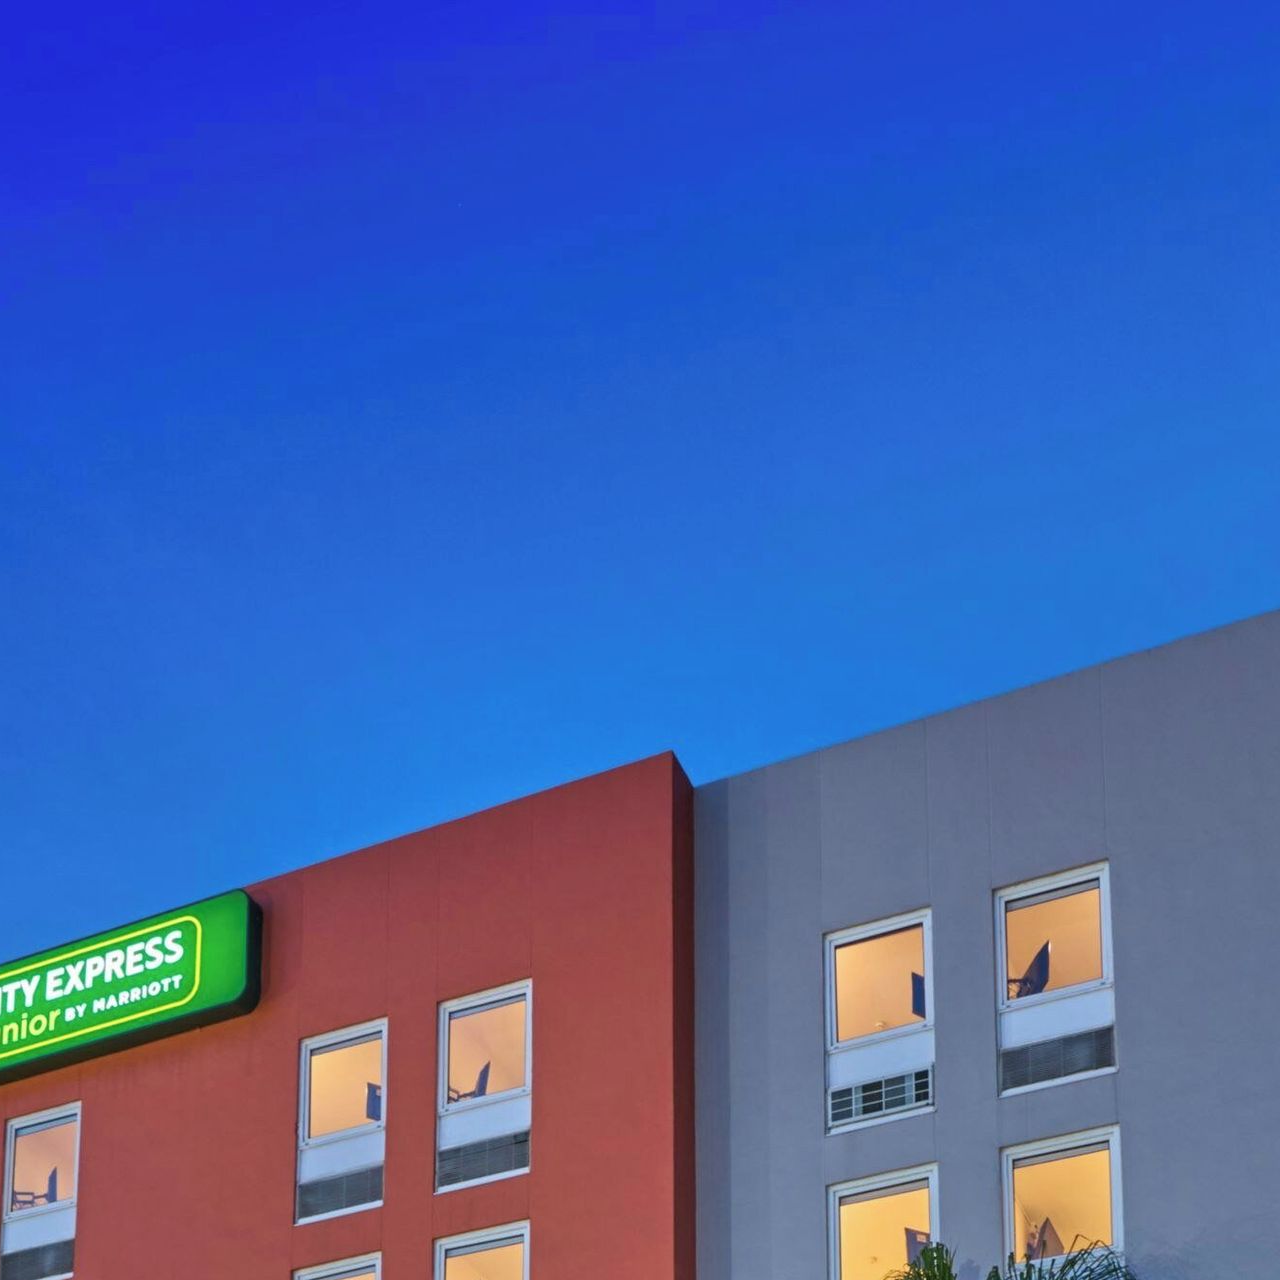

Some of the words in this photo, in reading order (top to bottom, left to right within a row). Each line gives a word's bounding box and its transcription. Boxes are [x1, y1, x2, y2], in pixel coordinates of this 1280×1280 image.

[45, 930, 184, 1001] EXPRESS
[64, 1003, 87, 1022] BY
[92, 974, 183, 1014] MARRIOTT
